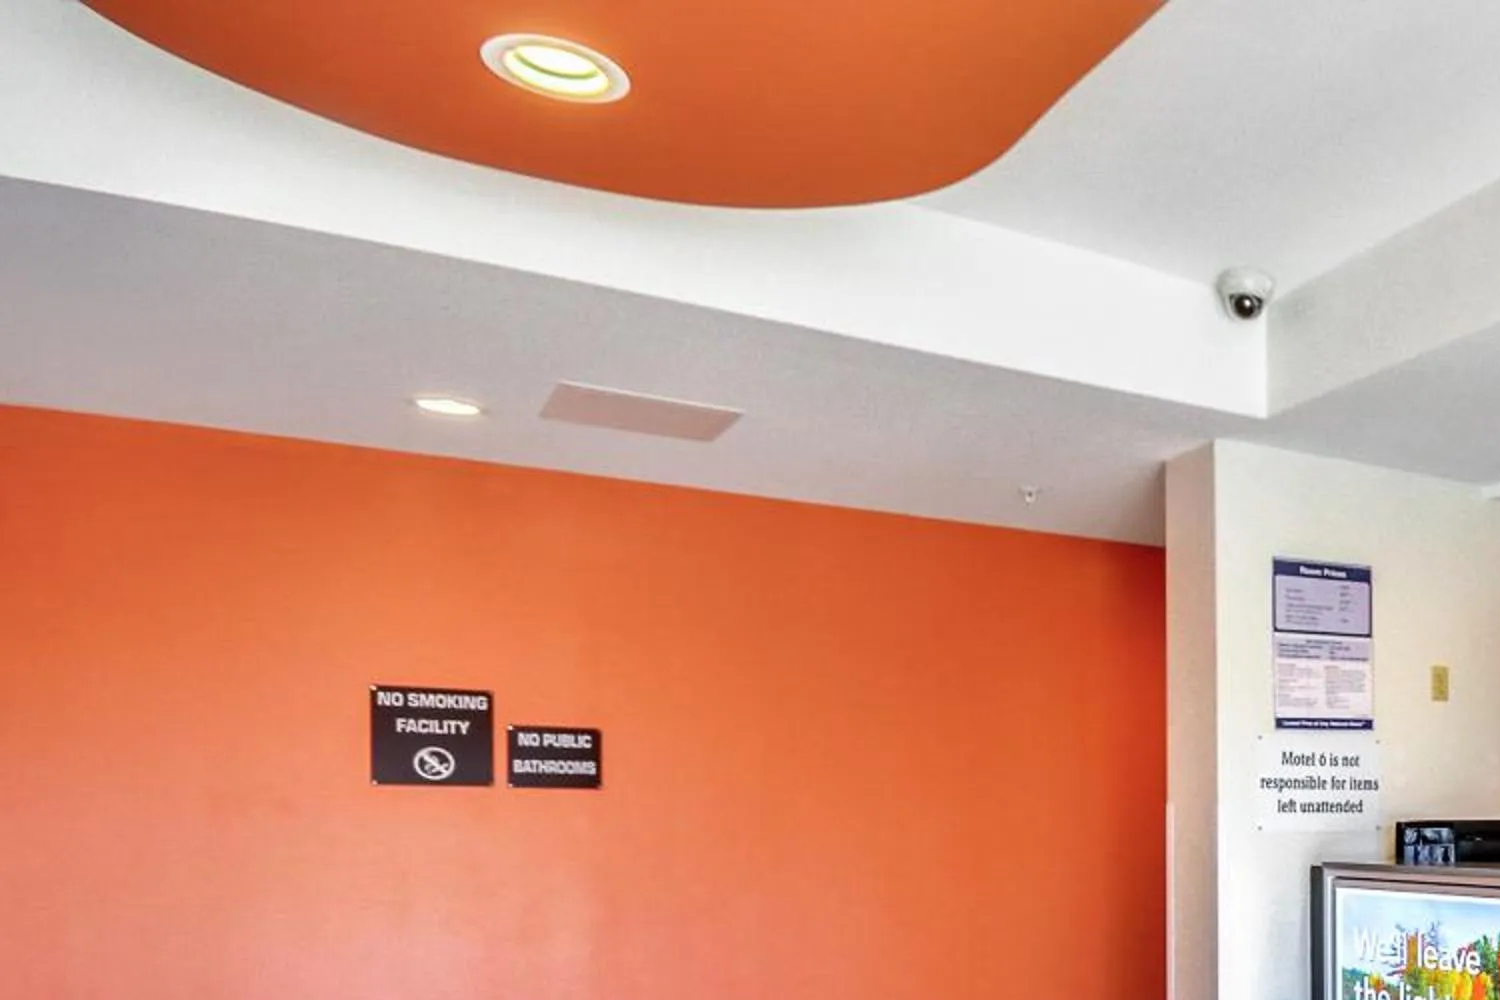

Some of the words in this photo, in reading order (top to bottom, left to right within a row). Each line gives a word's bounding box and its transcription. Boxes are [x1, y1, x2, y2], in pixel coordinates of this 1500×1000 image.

[377, 691, 404, 706] NO
[407, 695, 488, 711] SMOKING
[395, 718, 471, 735] FACILITY
[517, 733, 540, 747] NO
[543, 734, 592, 749] PUBLIC
[513, 759, 597, 775] BATHROOMS
[1281, 751, 1316, 767] Motel
[1318, 753, 1327, 767] 6
[1329, 753, 1339, 767] is
[1341, 756, 1360, 767] not
[1260, 776, 1328, 792] responsible
[1331, 776, 1347, 790] for
[1349, 777, 1379, 791] items
[1277, 799, 1297, 813] left
[1299, 799, 1364, 813] unattended
[1416, 931, 1481, 976] leave
